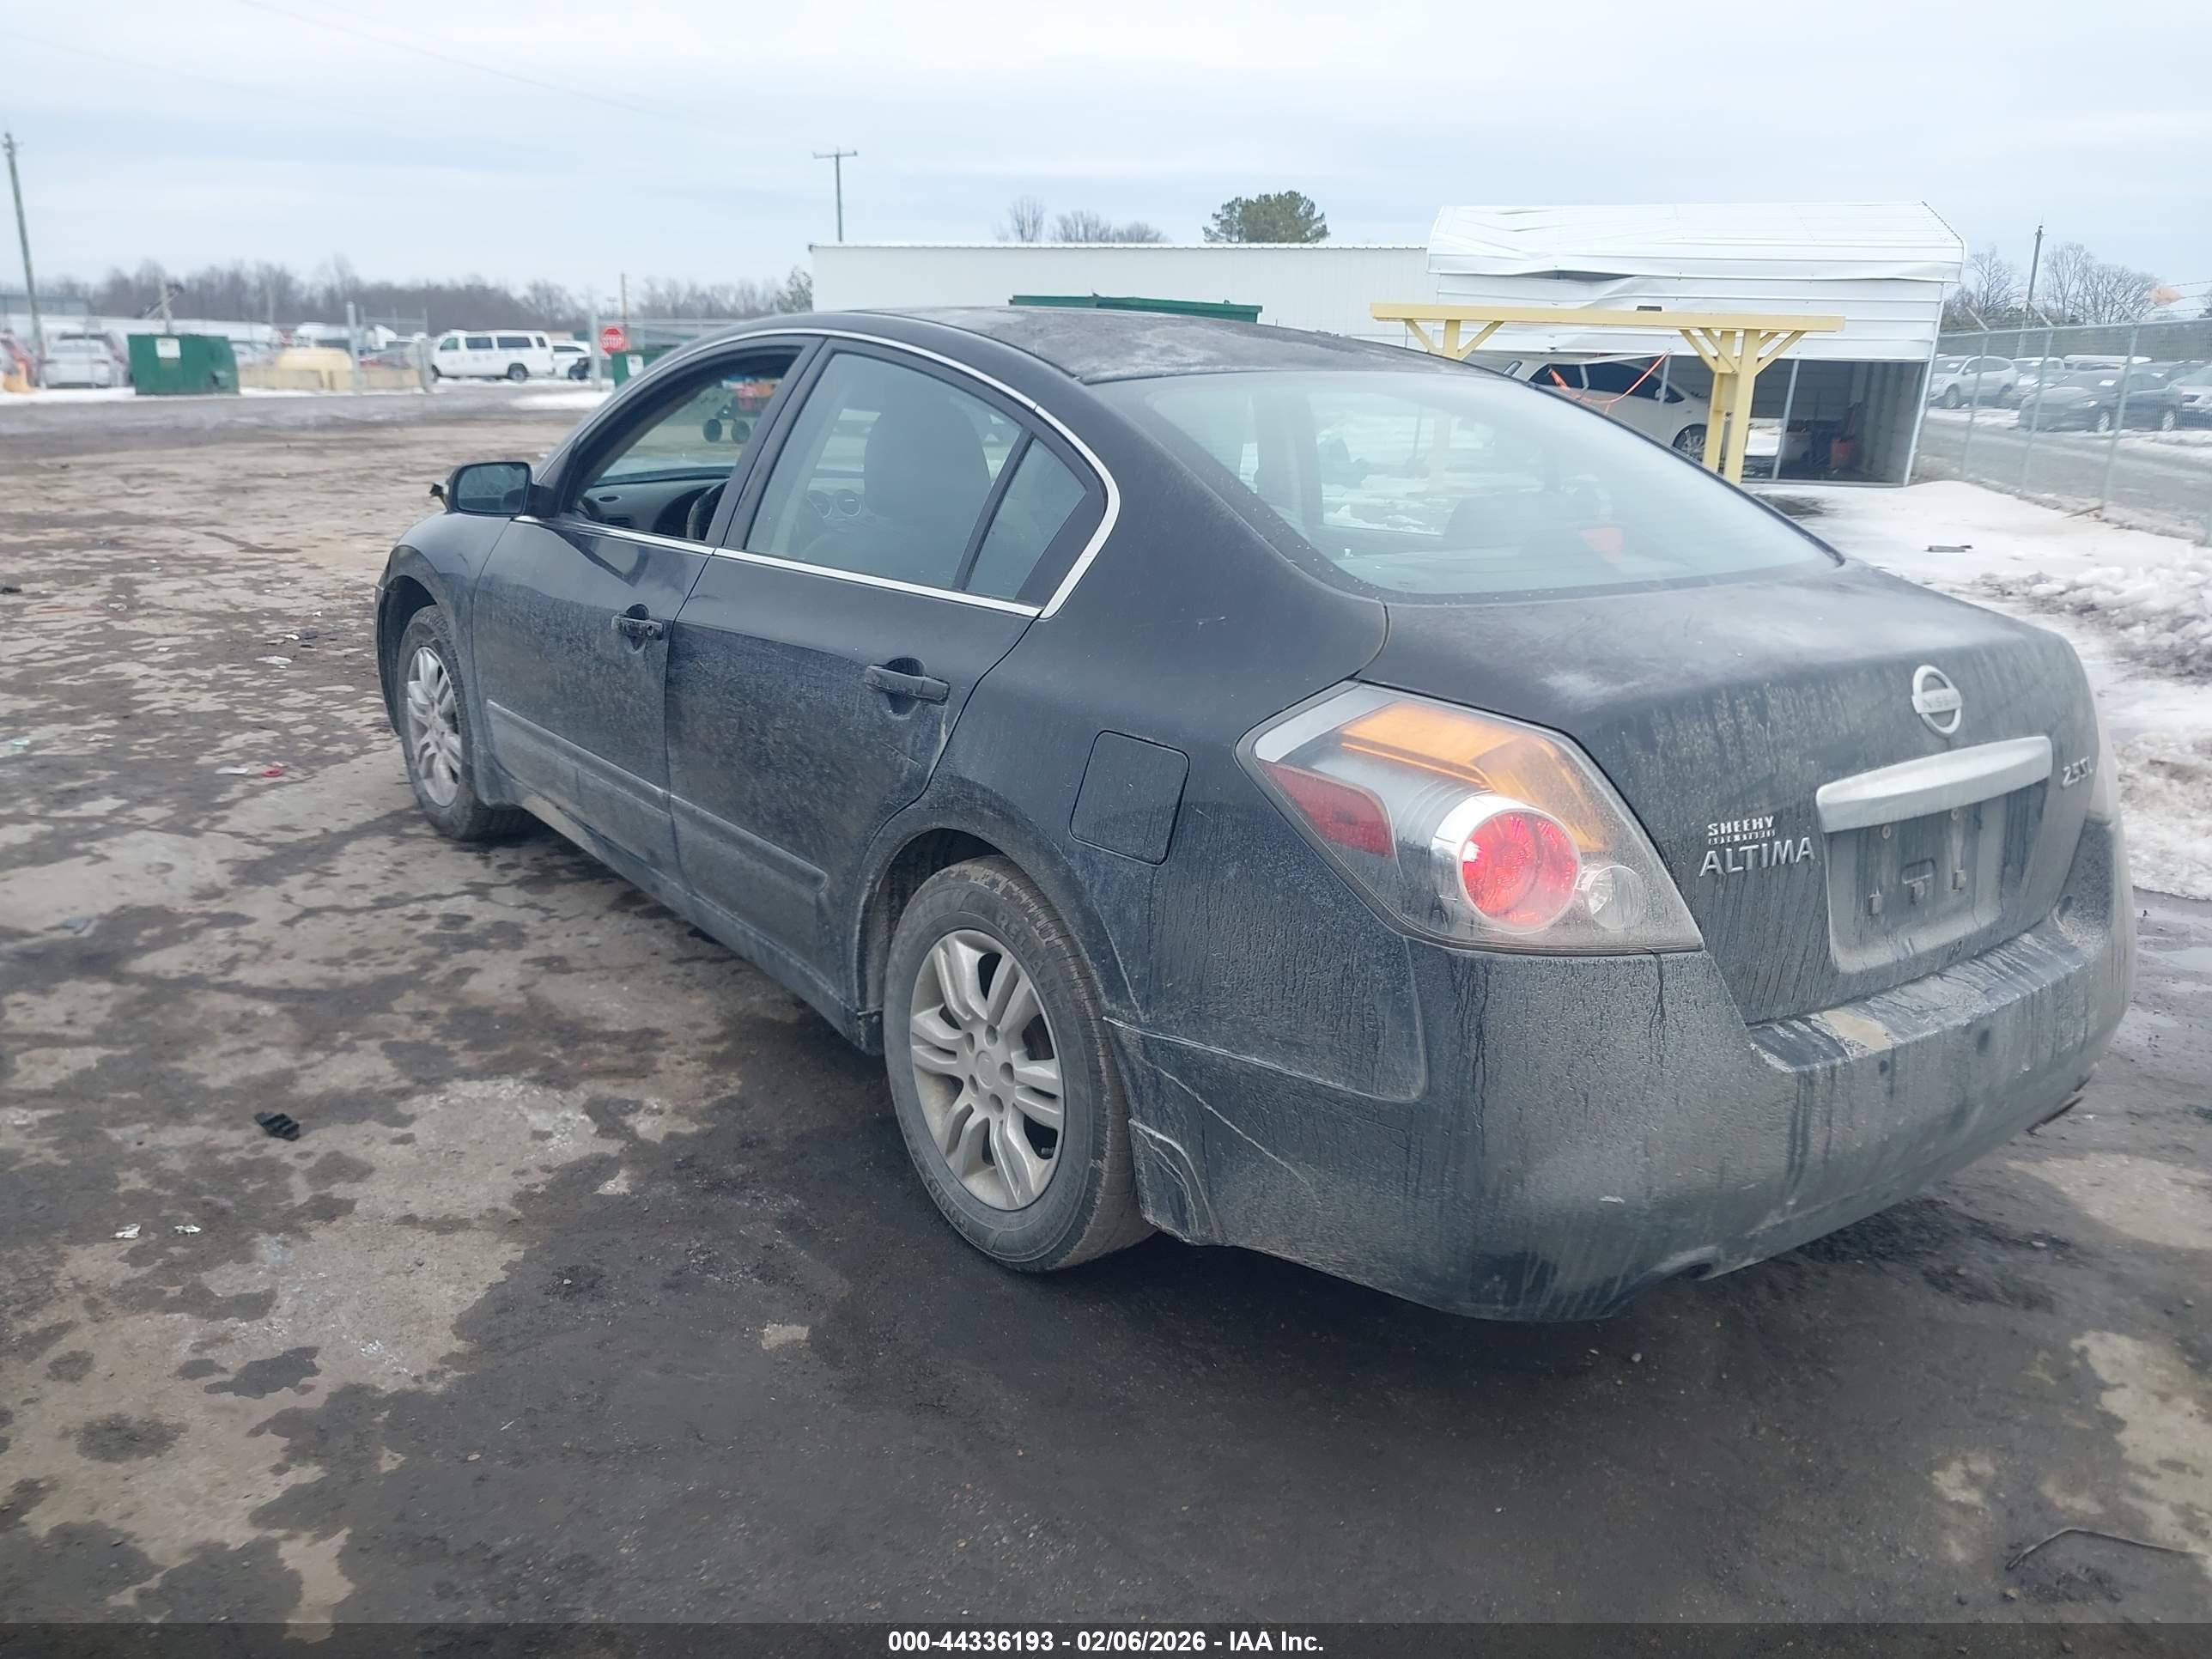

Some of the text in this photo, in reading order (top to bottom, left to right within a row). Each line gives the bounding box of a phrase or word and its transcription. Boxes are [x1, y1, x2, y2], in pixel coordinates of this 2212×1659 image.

[603, 336, 624, 348] STOP
[1708, 816, 1774, 836] SHEEHY
[1699, 836, 1815, 877] ALTIMA
